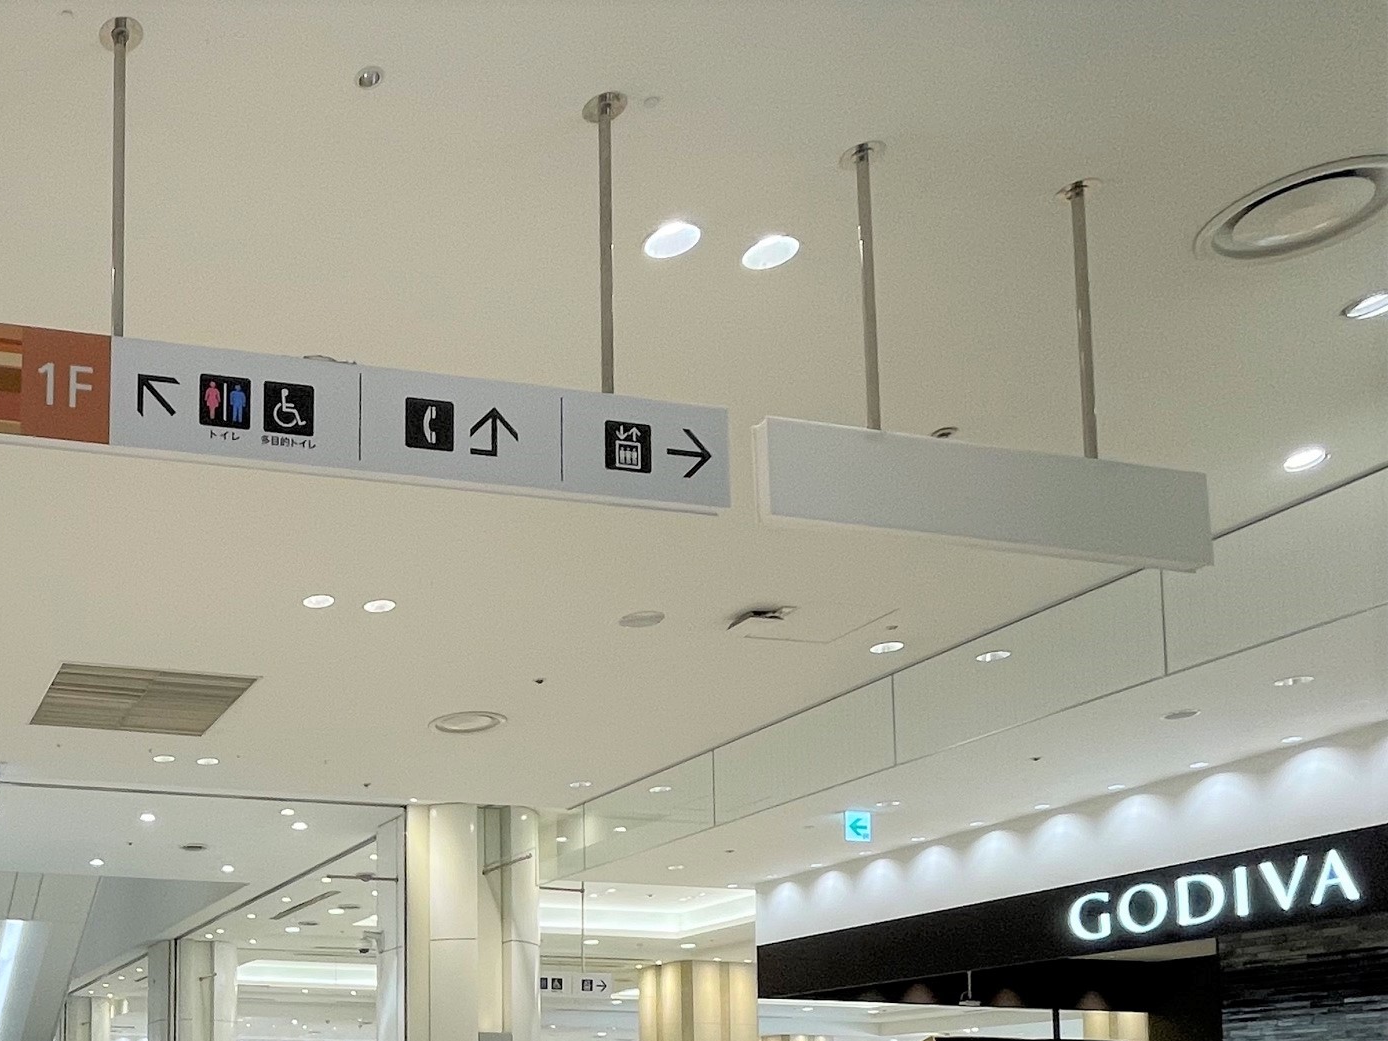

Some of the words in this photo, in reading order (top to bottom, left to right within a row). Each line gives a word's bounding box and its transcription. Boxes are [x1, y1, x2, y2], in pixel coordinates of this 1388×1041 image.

[37, 362, 94, 408] 1F
[209, 430, 241, 441] トイレ
[260, 434, 317, 450] 多目的トイレ
[1067, 848, 1361, 941] GODIVA
